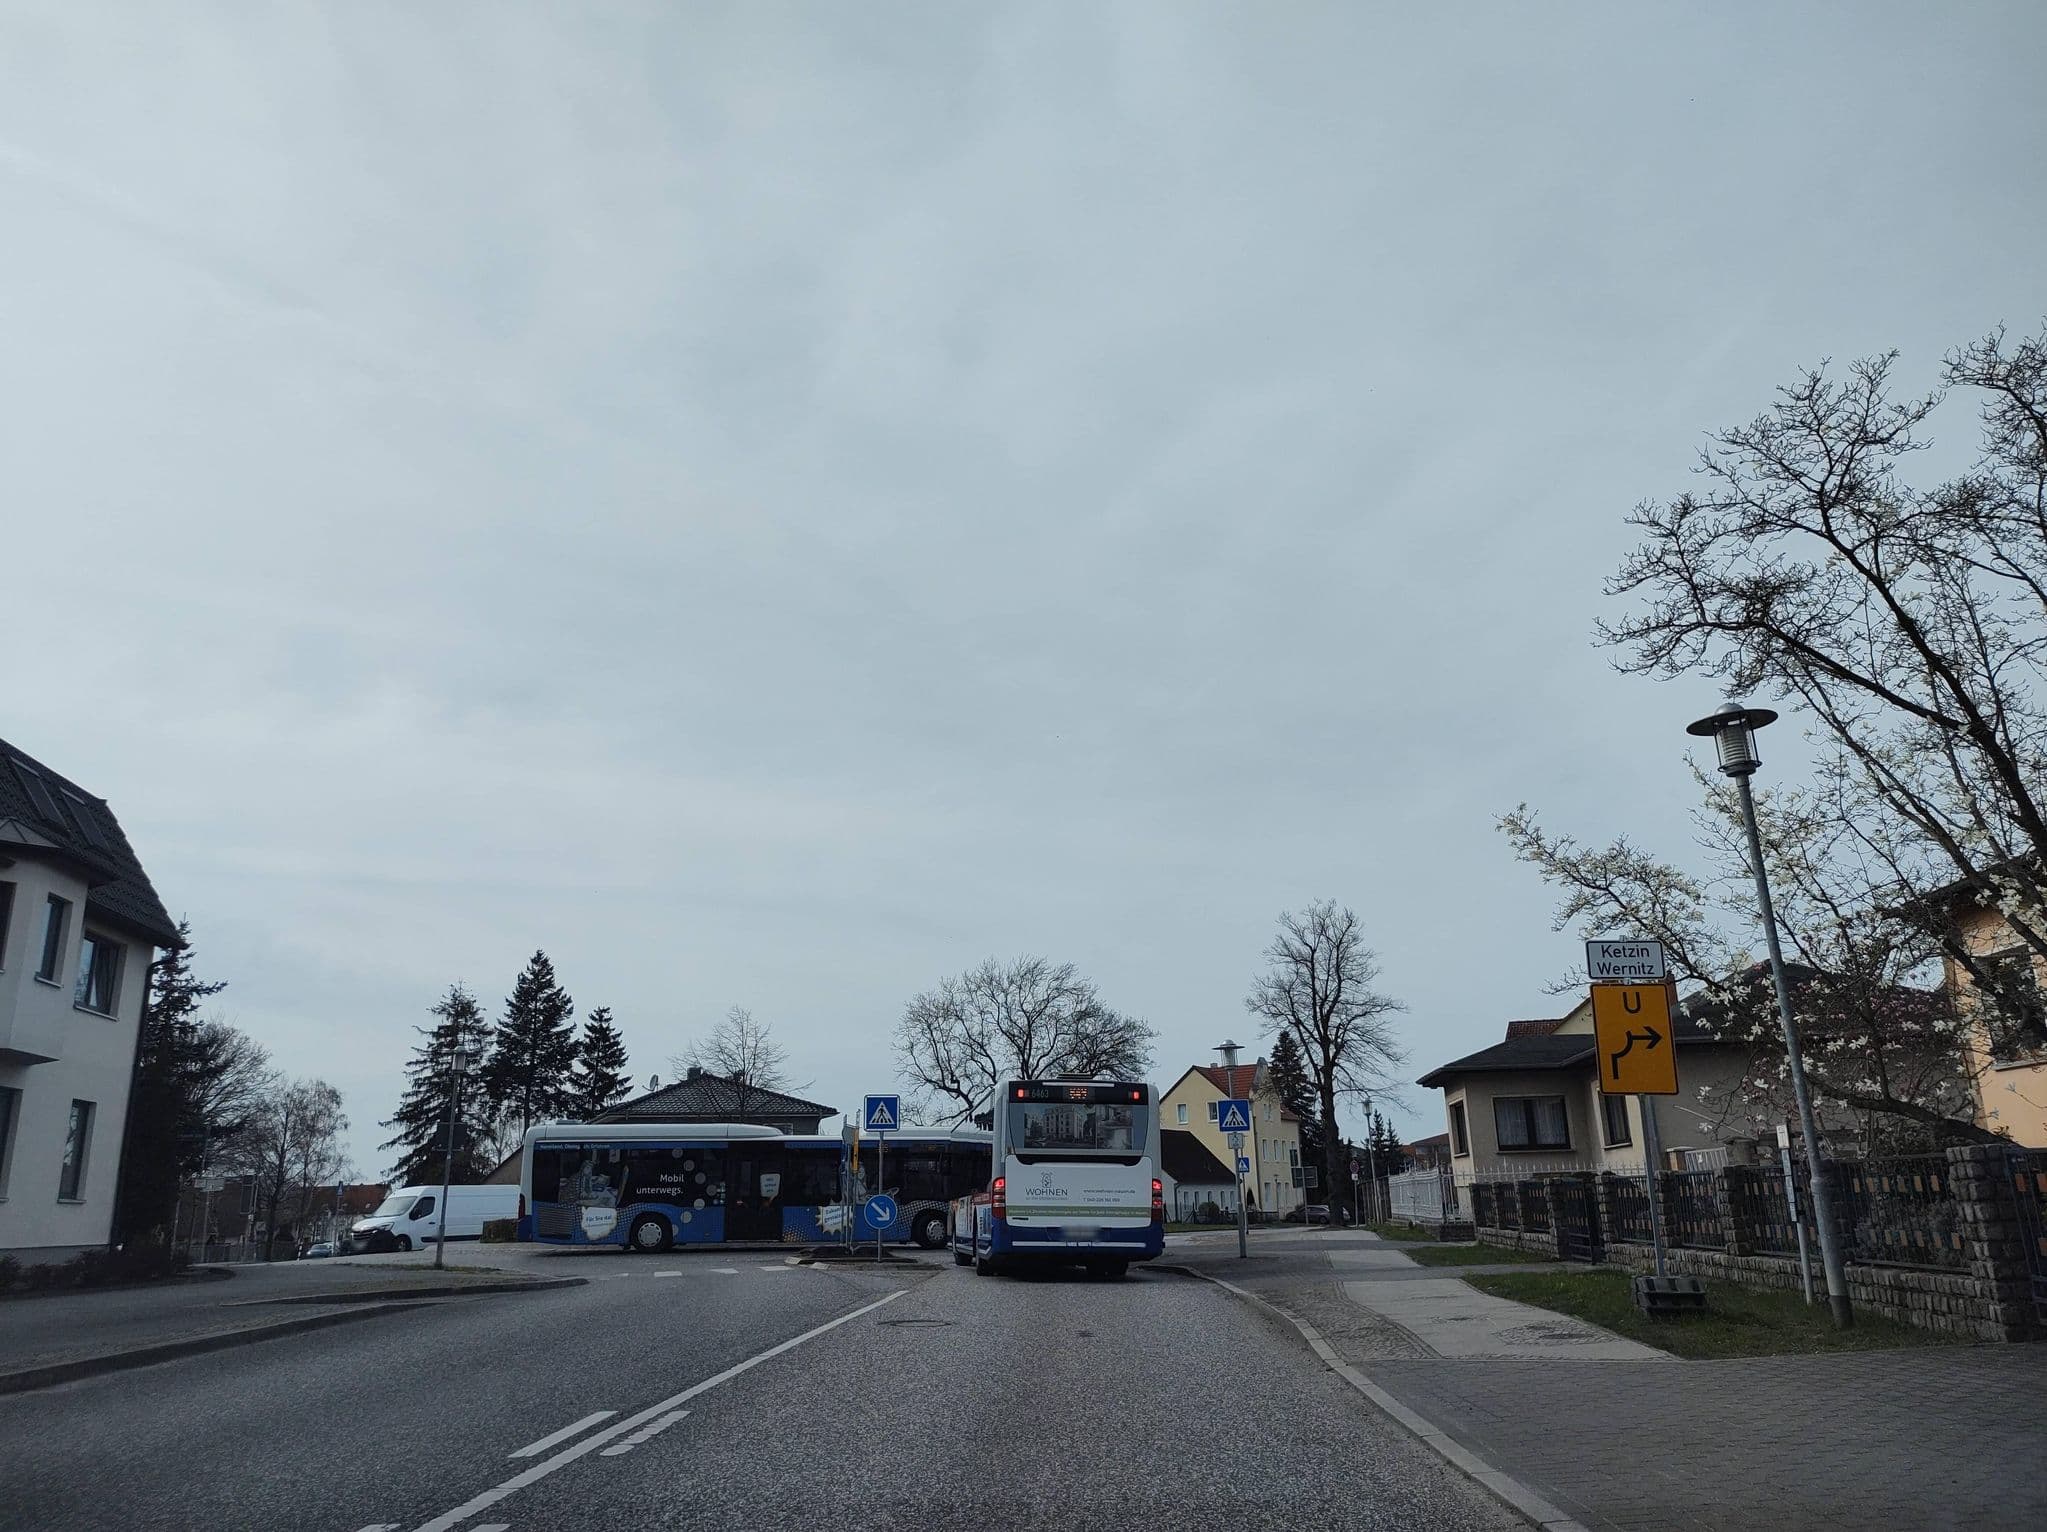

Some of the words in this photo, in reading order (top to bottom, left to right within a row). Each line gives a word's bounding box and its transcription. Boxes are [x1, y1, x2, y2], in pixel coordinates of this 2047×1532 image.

[1601, 944, 1650, 958] Ketzin
[1597, 961, 1655, 975] Wernitz
[1622, 991, 1641, 1014] U
[659, 1173, 684, 1183] Mobil
[636, 1187, 684, 1197] unterwegs.
[1025, 1188, 1068, 1196] WOHNEN
